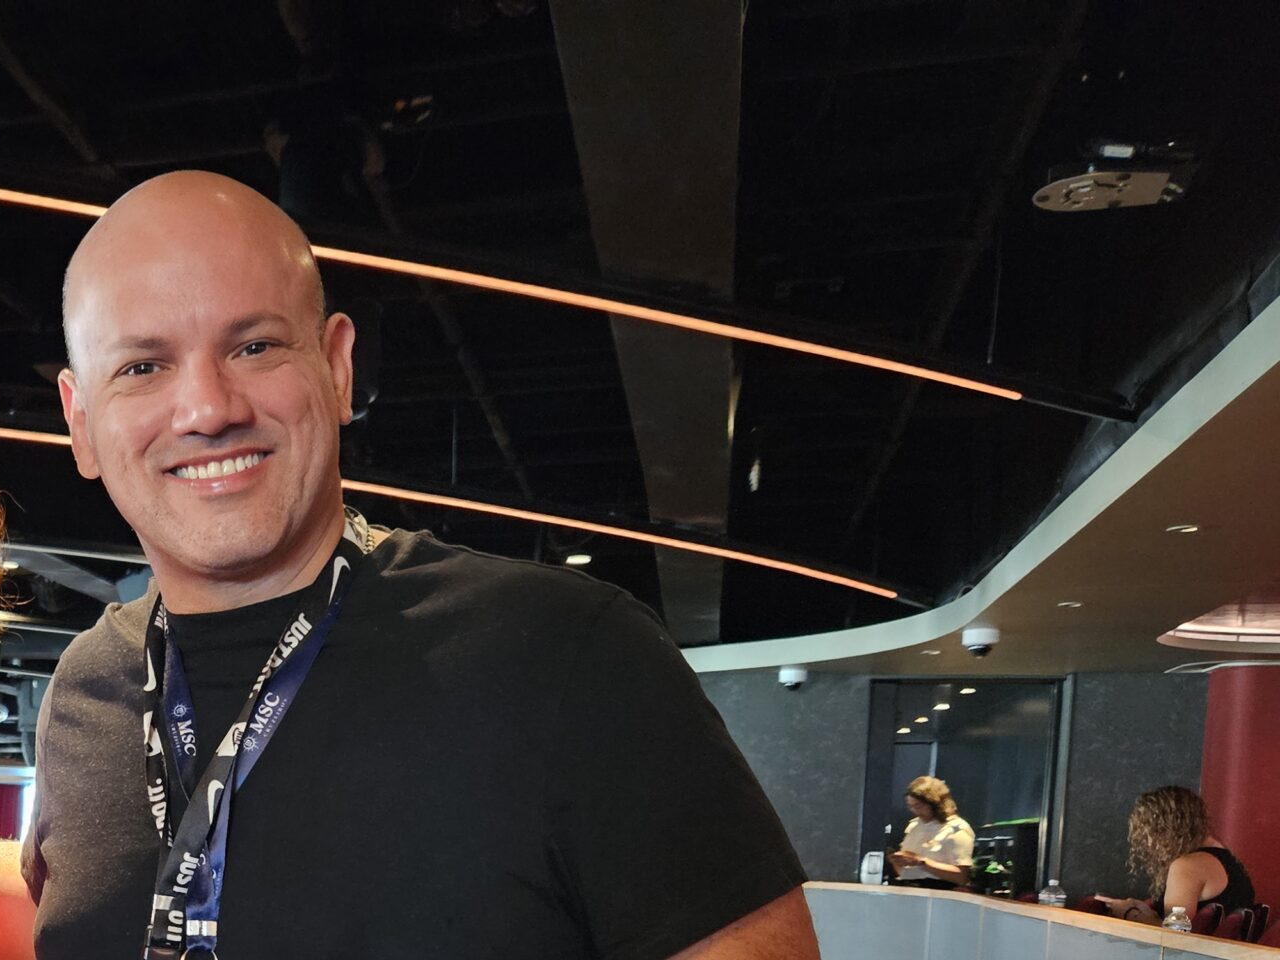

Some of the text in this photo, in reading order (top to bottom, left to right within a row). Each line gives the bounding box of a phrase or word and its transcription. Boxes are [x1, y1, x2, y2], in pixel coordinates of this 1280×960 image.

[278, 612, 312, 659] JUST
[249, 692, 280, 735] MSC
[177, 719, 196, 756] MSC
